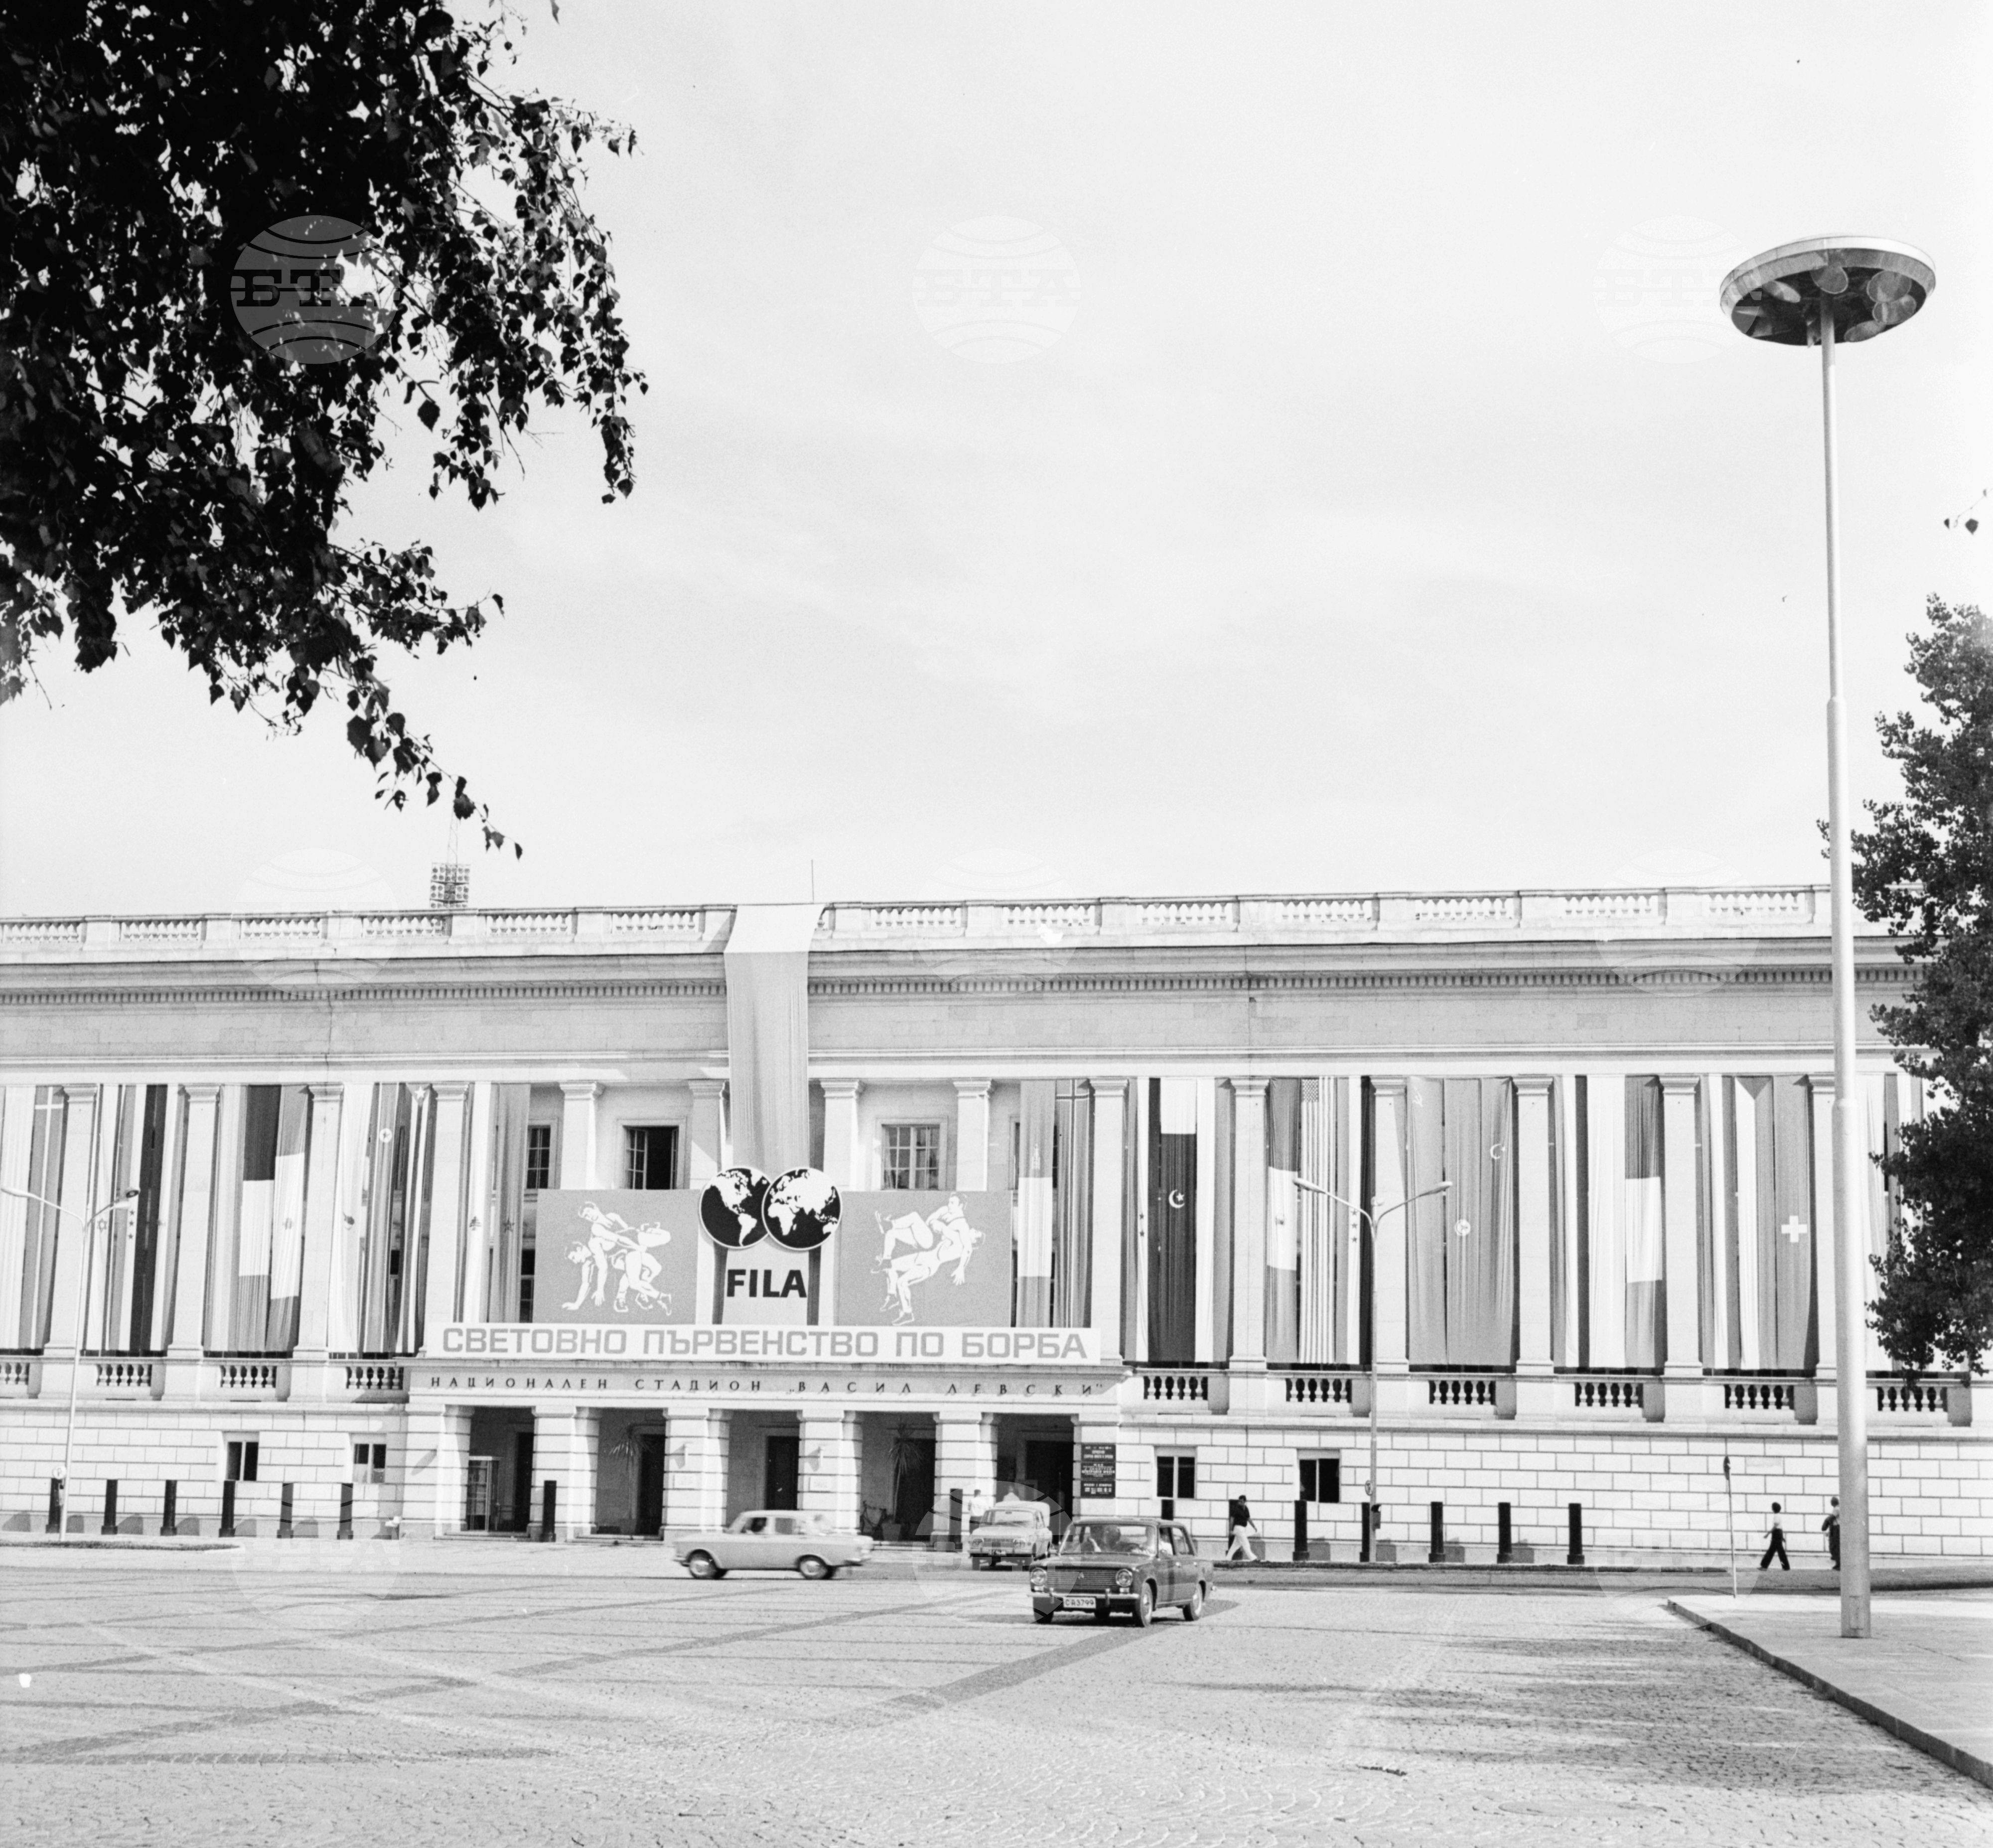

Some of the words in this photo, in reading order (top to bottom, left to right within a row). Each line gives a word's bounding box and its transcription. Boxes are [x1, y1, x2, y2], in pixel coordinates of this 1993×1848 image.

[726, 1269, 807, 1298] FILA
[443, 1328, 627, 1354] СВЕТОВНО
[643, 1330, 879, 1357] ПЪРВЕНСТВО
[895, 1332, 944, 1357] ПО
[962, 1333, 1088, 1359] БОРБА
[431, 1377, 607, 1389] НАЦИОНАЛЕН
[635, 1379, 761, 1391] СТАДИОН
